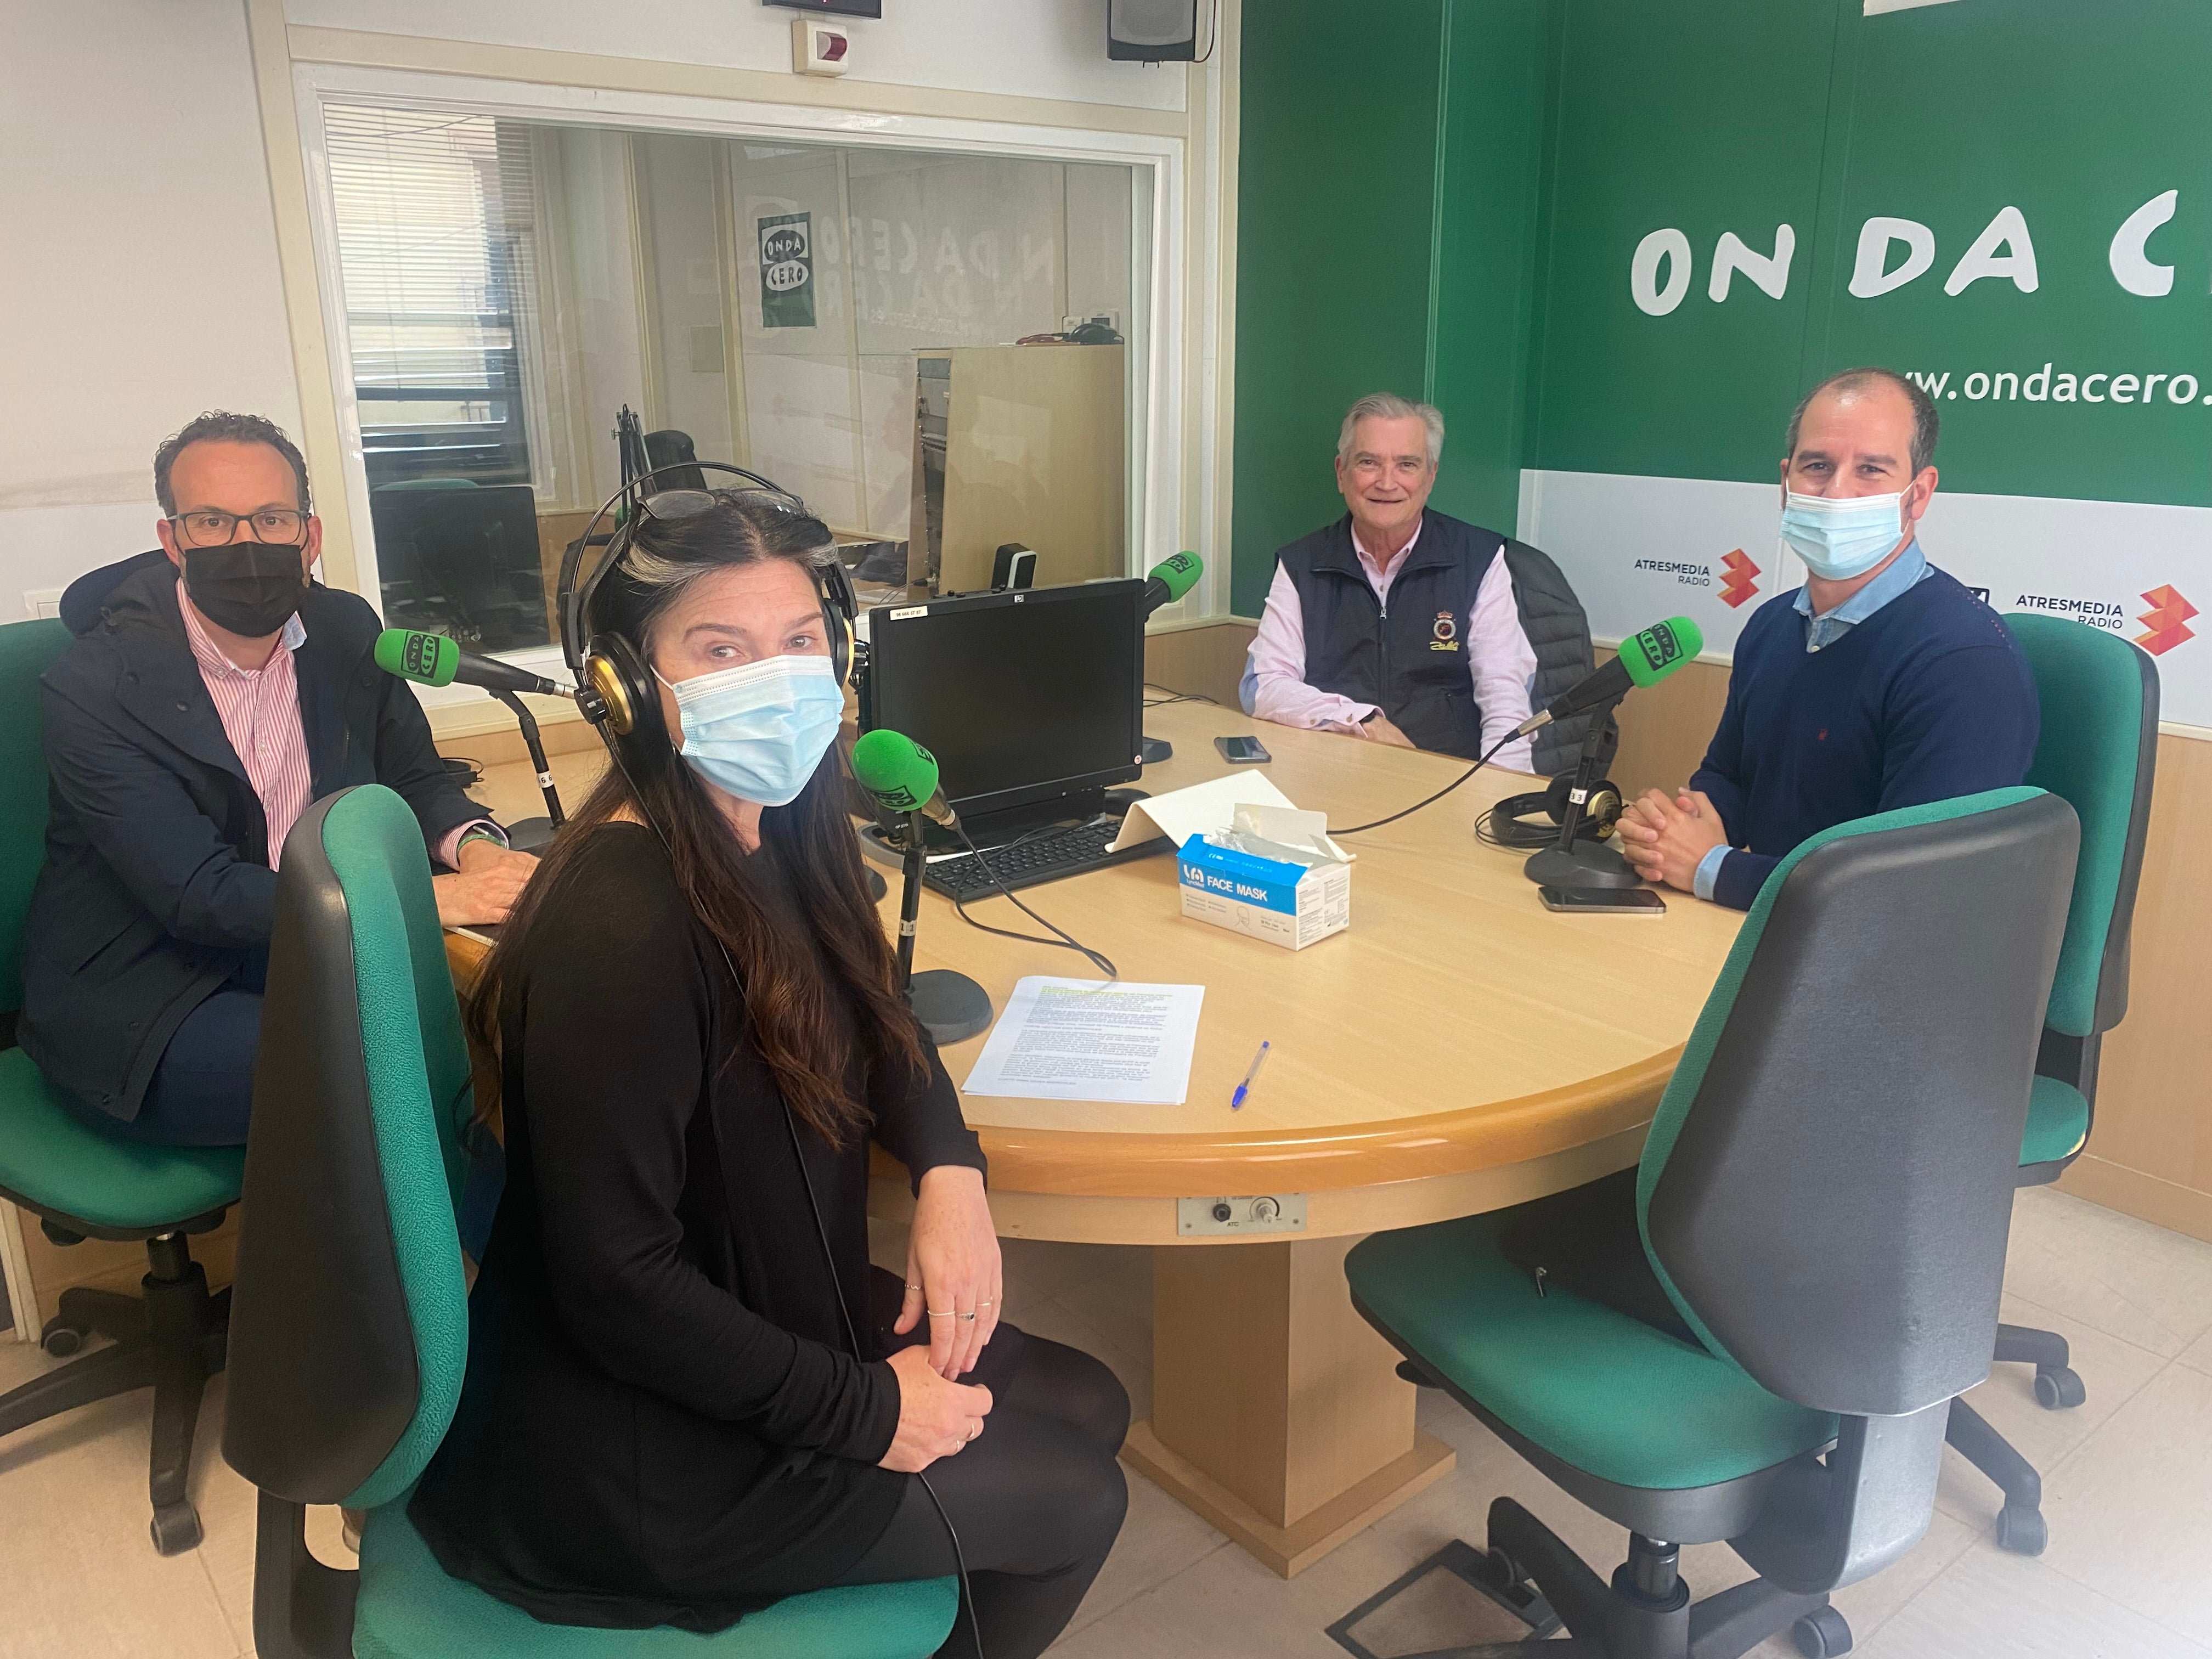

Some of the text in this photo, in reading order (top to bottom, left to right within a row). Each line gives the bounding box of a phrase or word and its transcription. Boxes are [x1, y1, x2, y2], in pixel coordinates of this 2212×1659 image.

[768, 237, 801, 256] ONDA
[2109, 189, 2212, 297] C
[771, 267, 803, 285] CERO
[1634, 559, 1710, 576] ATRESMEDIA
[1678, 575, 1710, 586] RADIO
[2016, 594, 2124, 617] ATRESMEDIA
[2078, 615, 2123, 629] RADIO
[1643, 632, 1662, 661] CERO
[1654, 624, 1673, 655] ONDA
[409, 636, 420, 668] ONDA
[422, 639, 433, 670] CERO
[1207, 876, 1268, 902] FACE MASK
